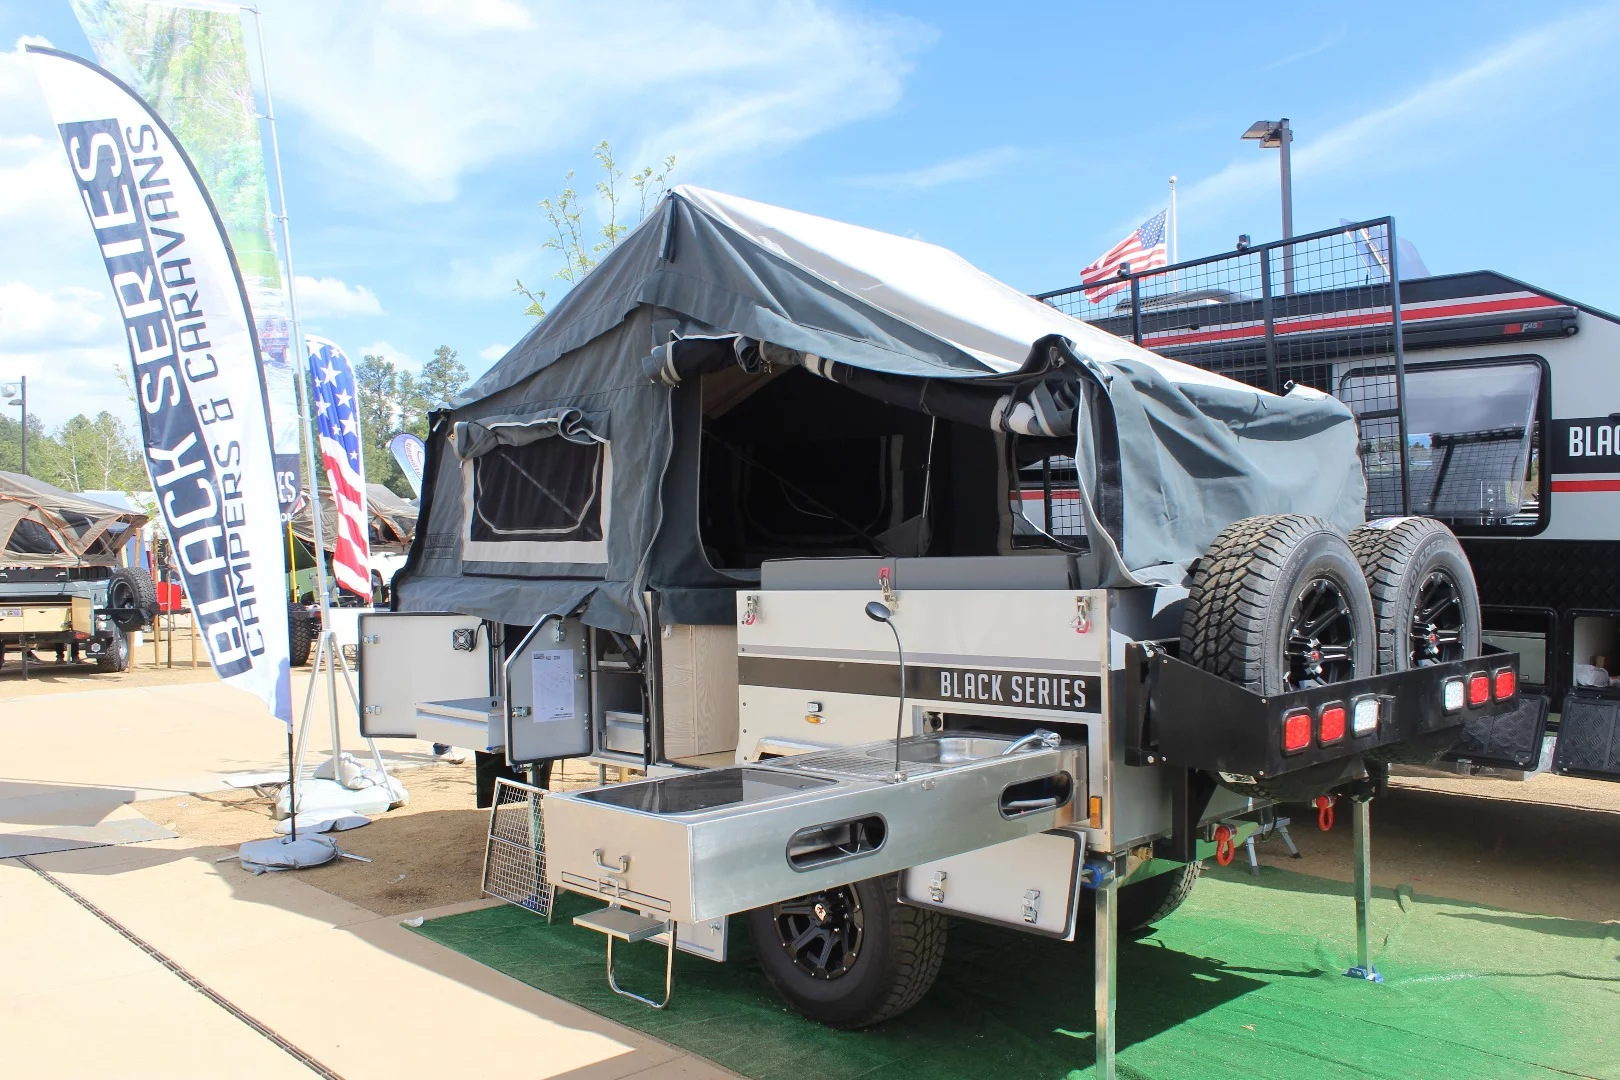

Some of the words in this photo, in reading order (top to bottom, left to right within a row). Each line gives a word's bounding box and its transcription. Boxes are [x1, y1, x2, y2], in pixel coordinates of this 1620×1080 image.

[70, 132, 181, 415] SERIES
[126, 124, 219, 383] CARAVANS
[199, 397, 234, 426] &
[149, 431, 247, 666] BLACK
[214, 440, 265, 657] CAMPERS
[940, 671, 1003, 702] BLACK
[1011, 675, 1086, 708] SERIES
